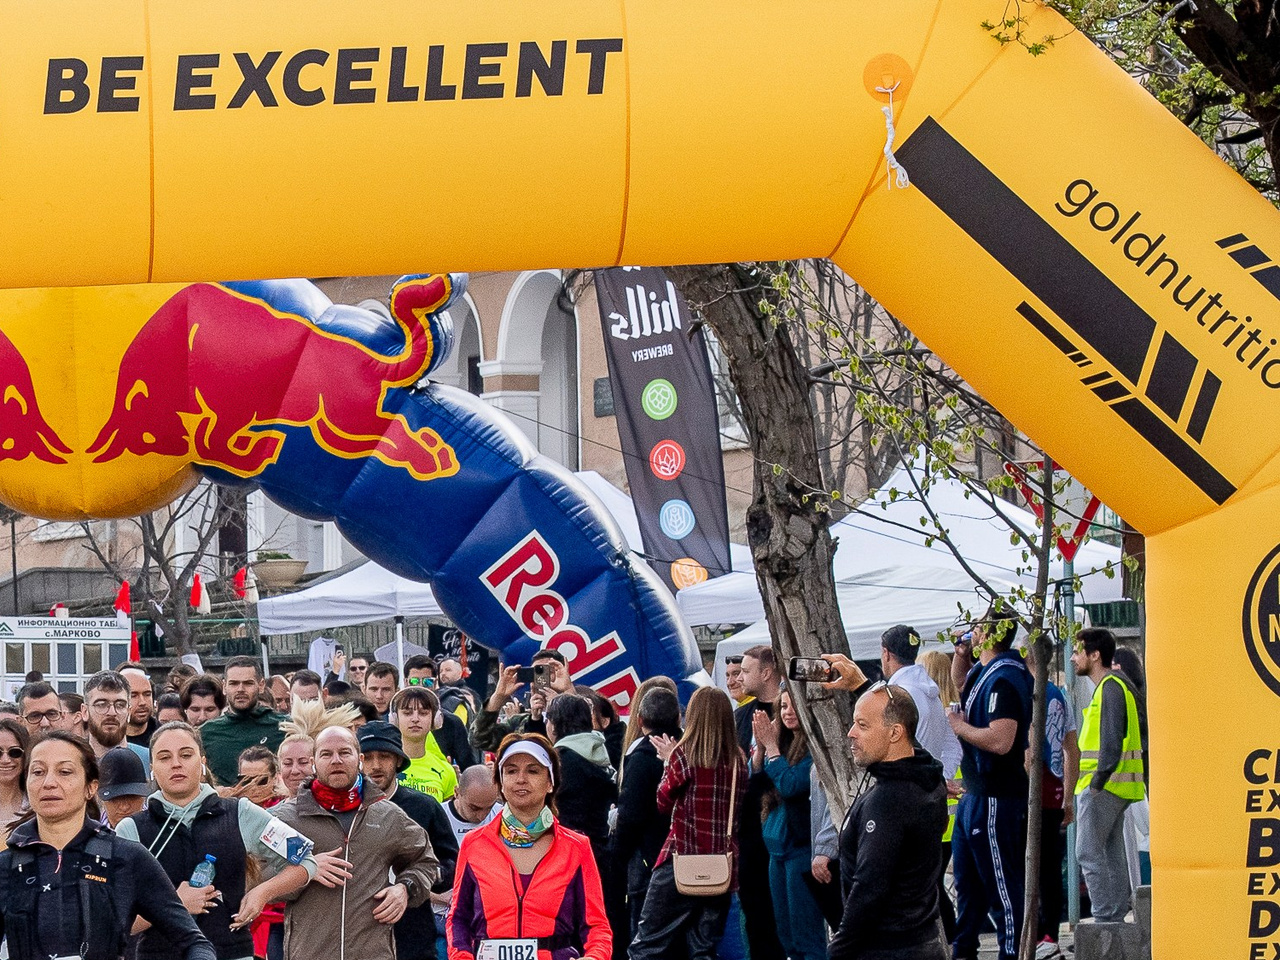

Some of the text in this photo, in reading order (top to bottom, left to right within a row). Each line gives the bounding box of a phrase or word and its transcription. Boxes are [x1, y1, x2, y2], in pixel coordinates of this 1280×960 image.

[43, 38, 624, 115] BE EXCELLENT
[1054, 178, 1280, 390] goldnutritio
[17, 619, 96, 627] ИНФОРМАЦИОННО
[483, 534, 622, 679] Red
